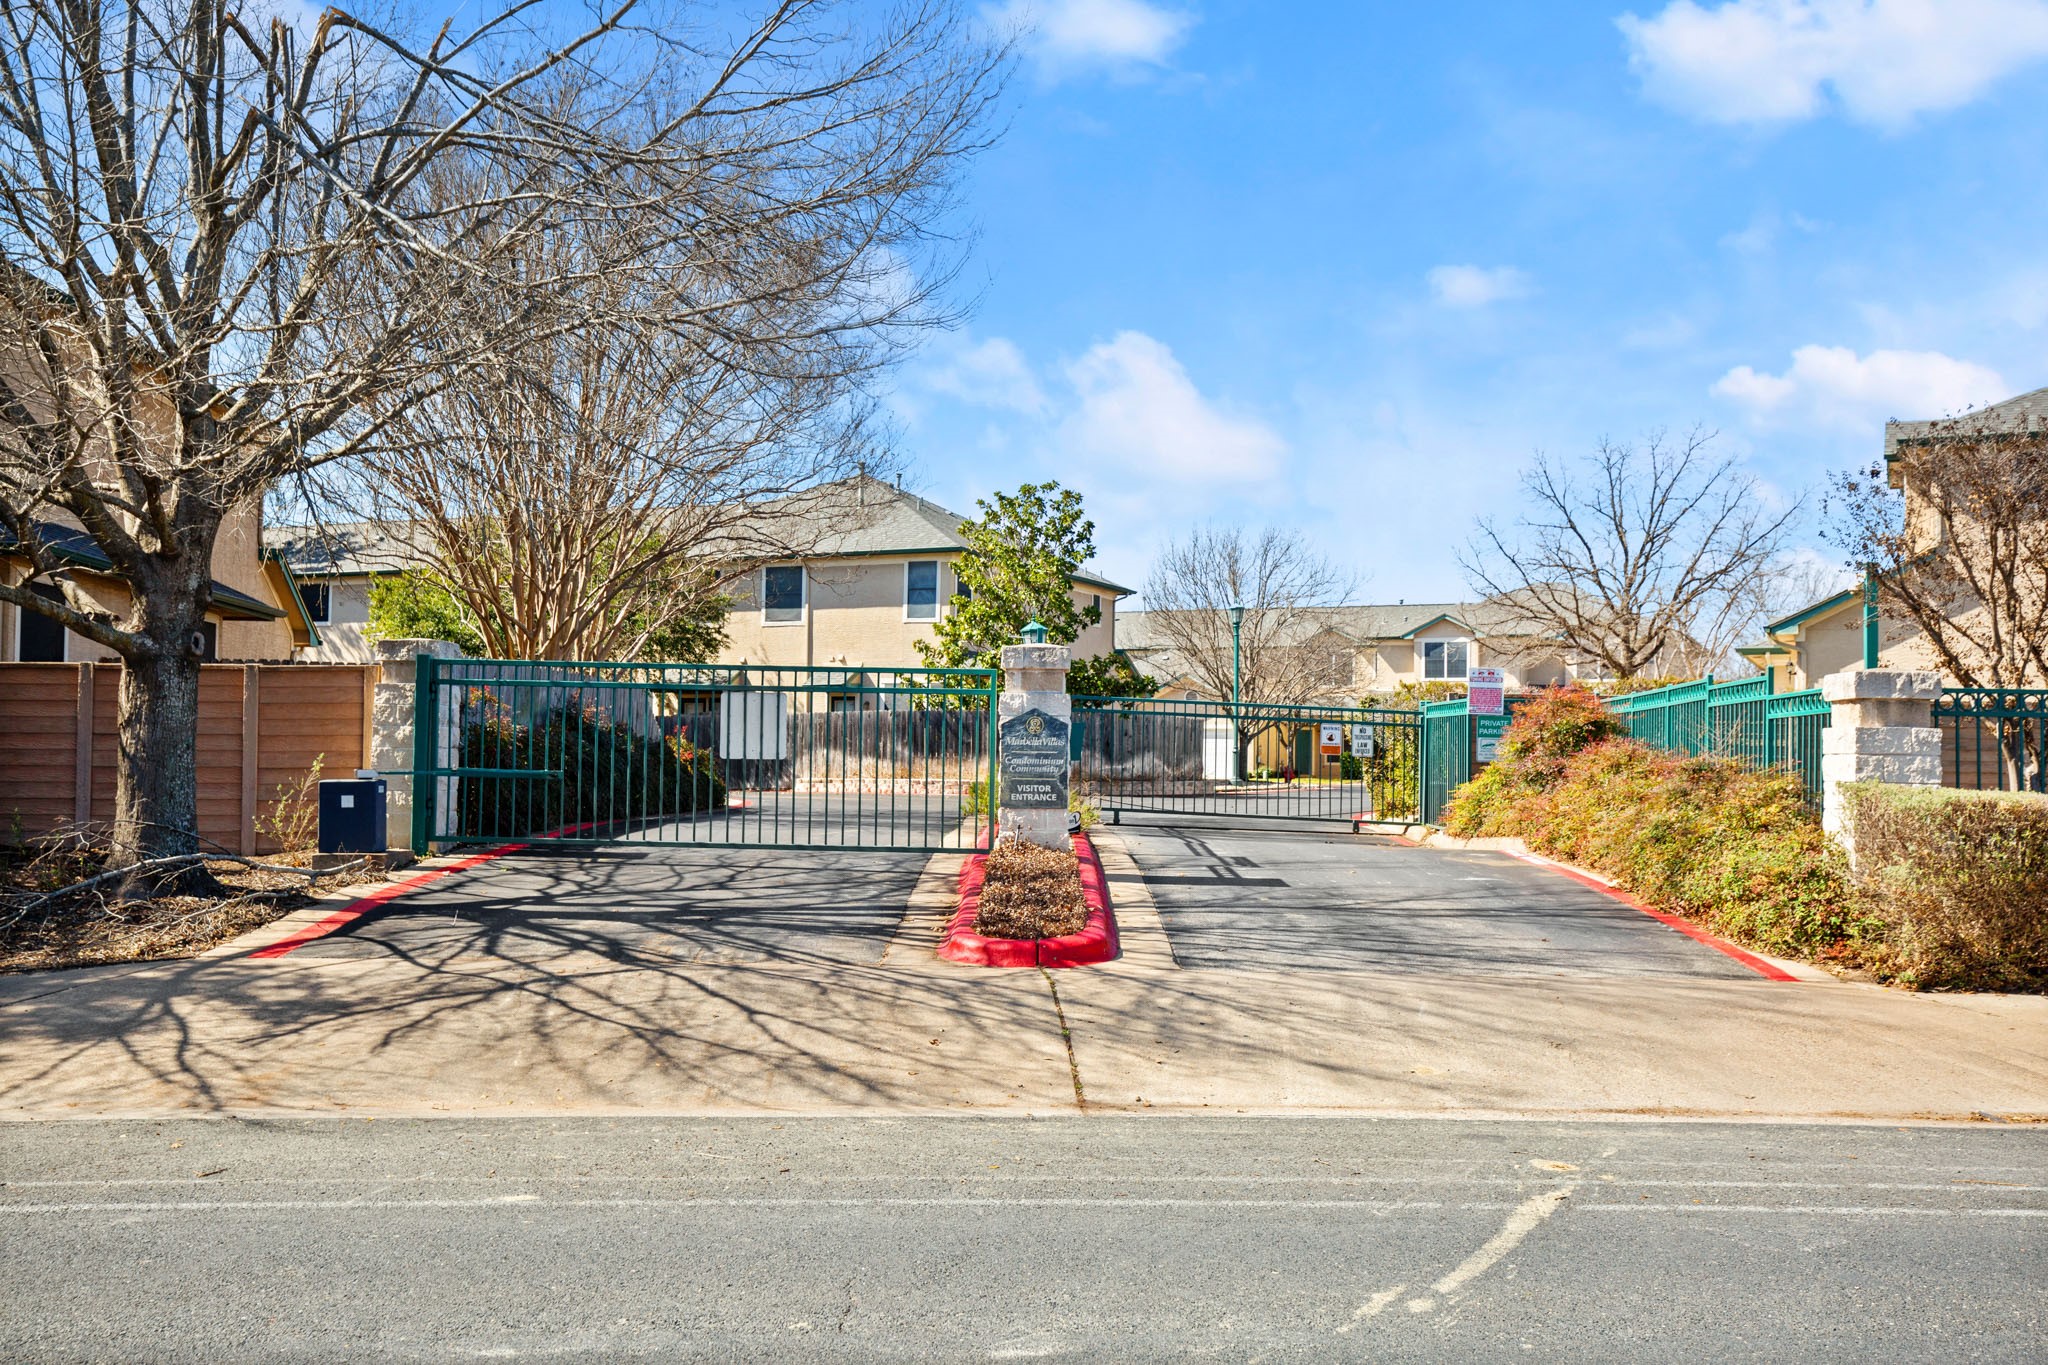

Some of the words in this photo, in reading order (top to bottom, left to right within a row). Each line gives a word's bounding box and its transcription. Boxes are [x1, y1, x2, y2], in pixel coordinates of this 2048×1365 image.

[1005, 756, 1064, 765] Condominium
[1009, 765, 1059, 774] Community
[1017, 784, 1052, 792] VISITOR
[1011, 793, 1057, 801] ENTRANCE
